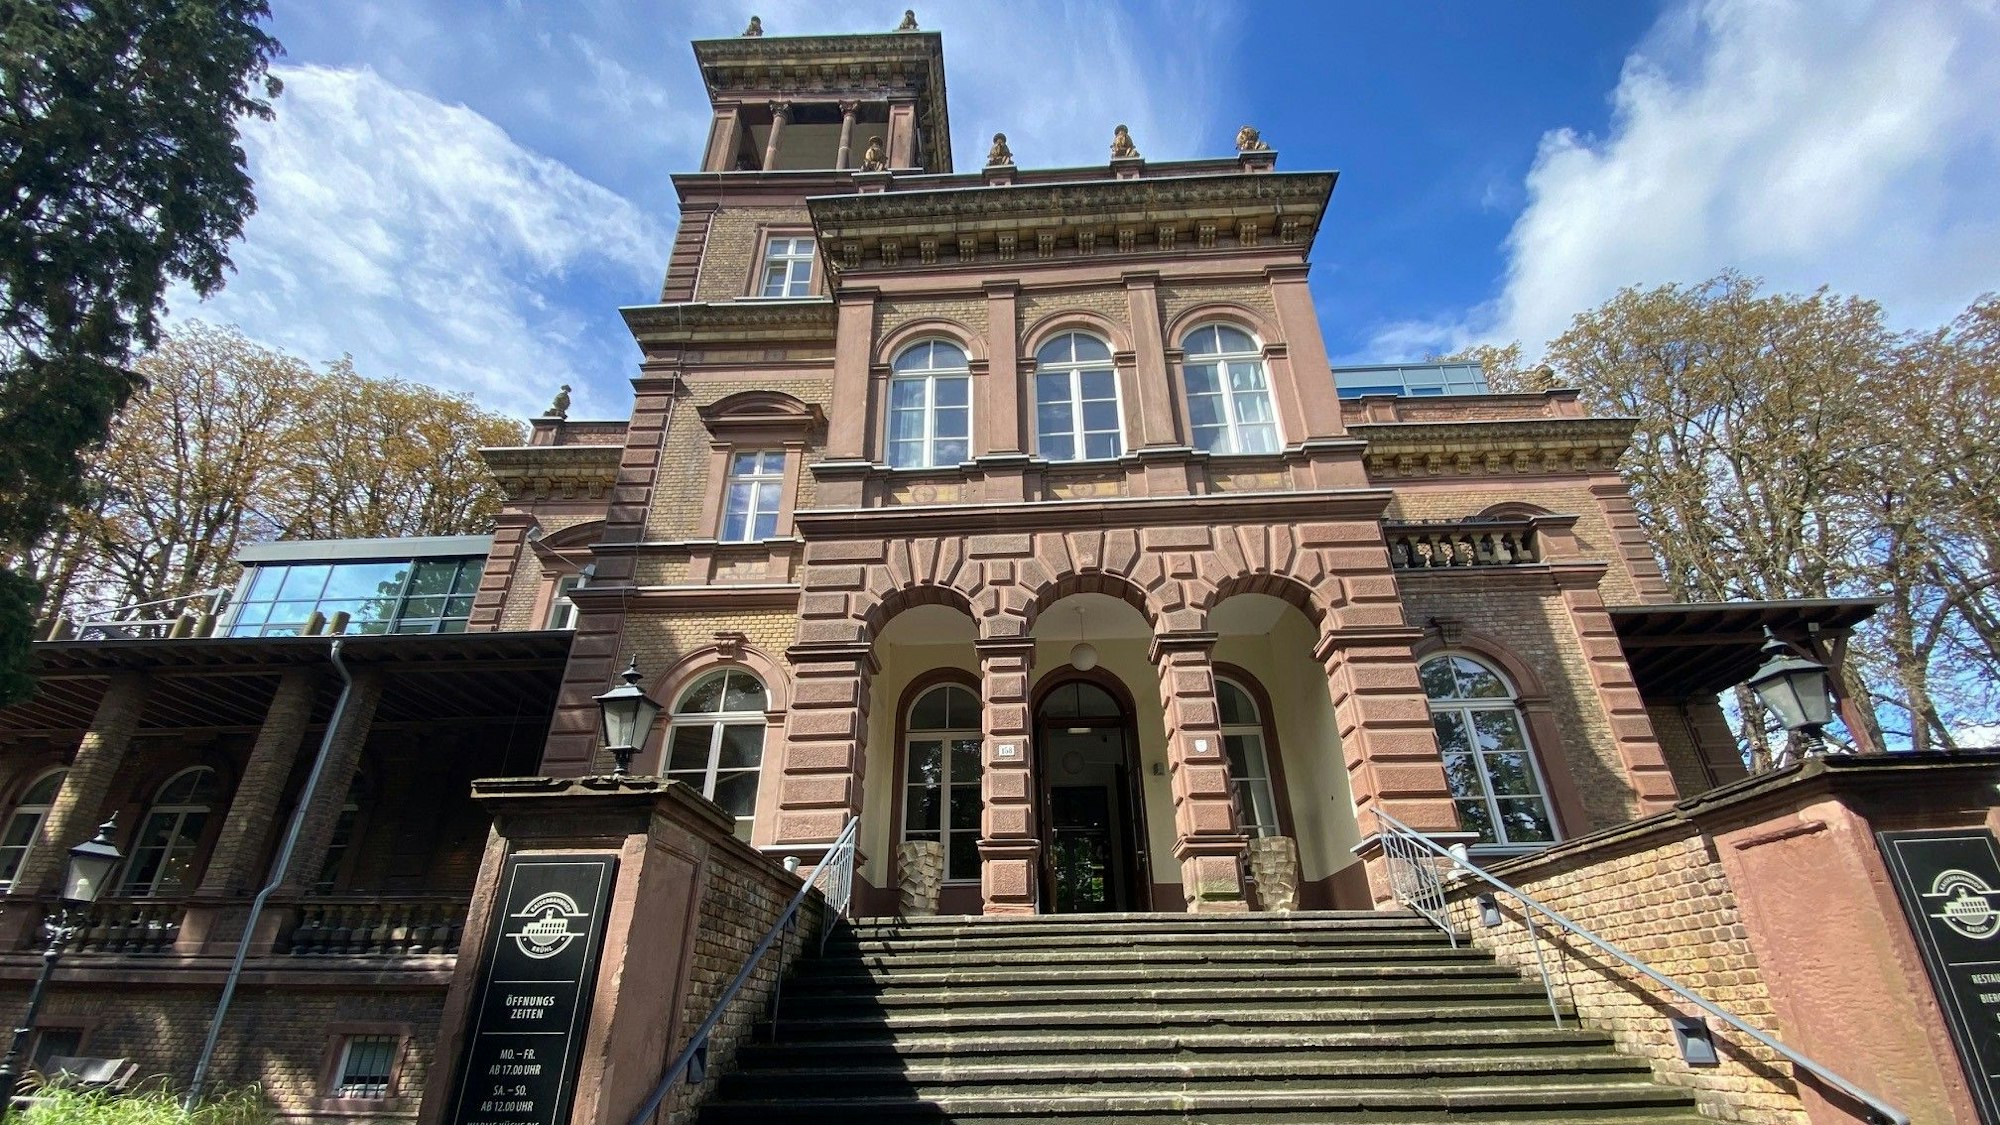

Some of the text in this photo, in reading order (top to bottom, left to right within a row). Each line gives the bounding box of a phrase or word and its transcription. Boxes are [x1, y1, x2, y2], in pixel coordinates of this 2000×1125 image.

[506, 994, 555, 1006] ÖFFNUNGS
[510, 1008, 544, 1019] ZEITEN
[500, 1049, 515, 1060] MO.
[523, 1049, 536, 1060] FR.
[489, 1064, 541, 1075] AB 17.00 UHR
[493, 1085, 506, 1096] SA.
[514, 1085, 527, 1096] SO.
[481, 1101, 534, 1112] AB 12.00 UHR
